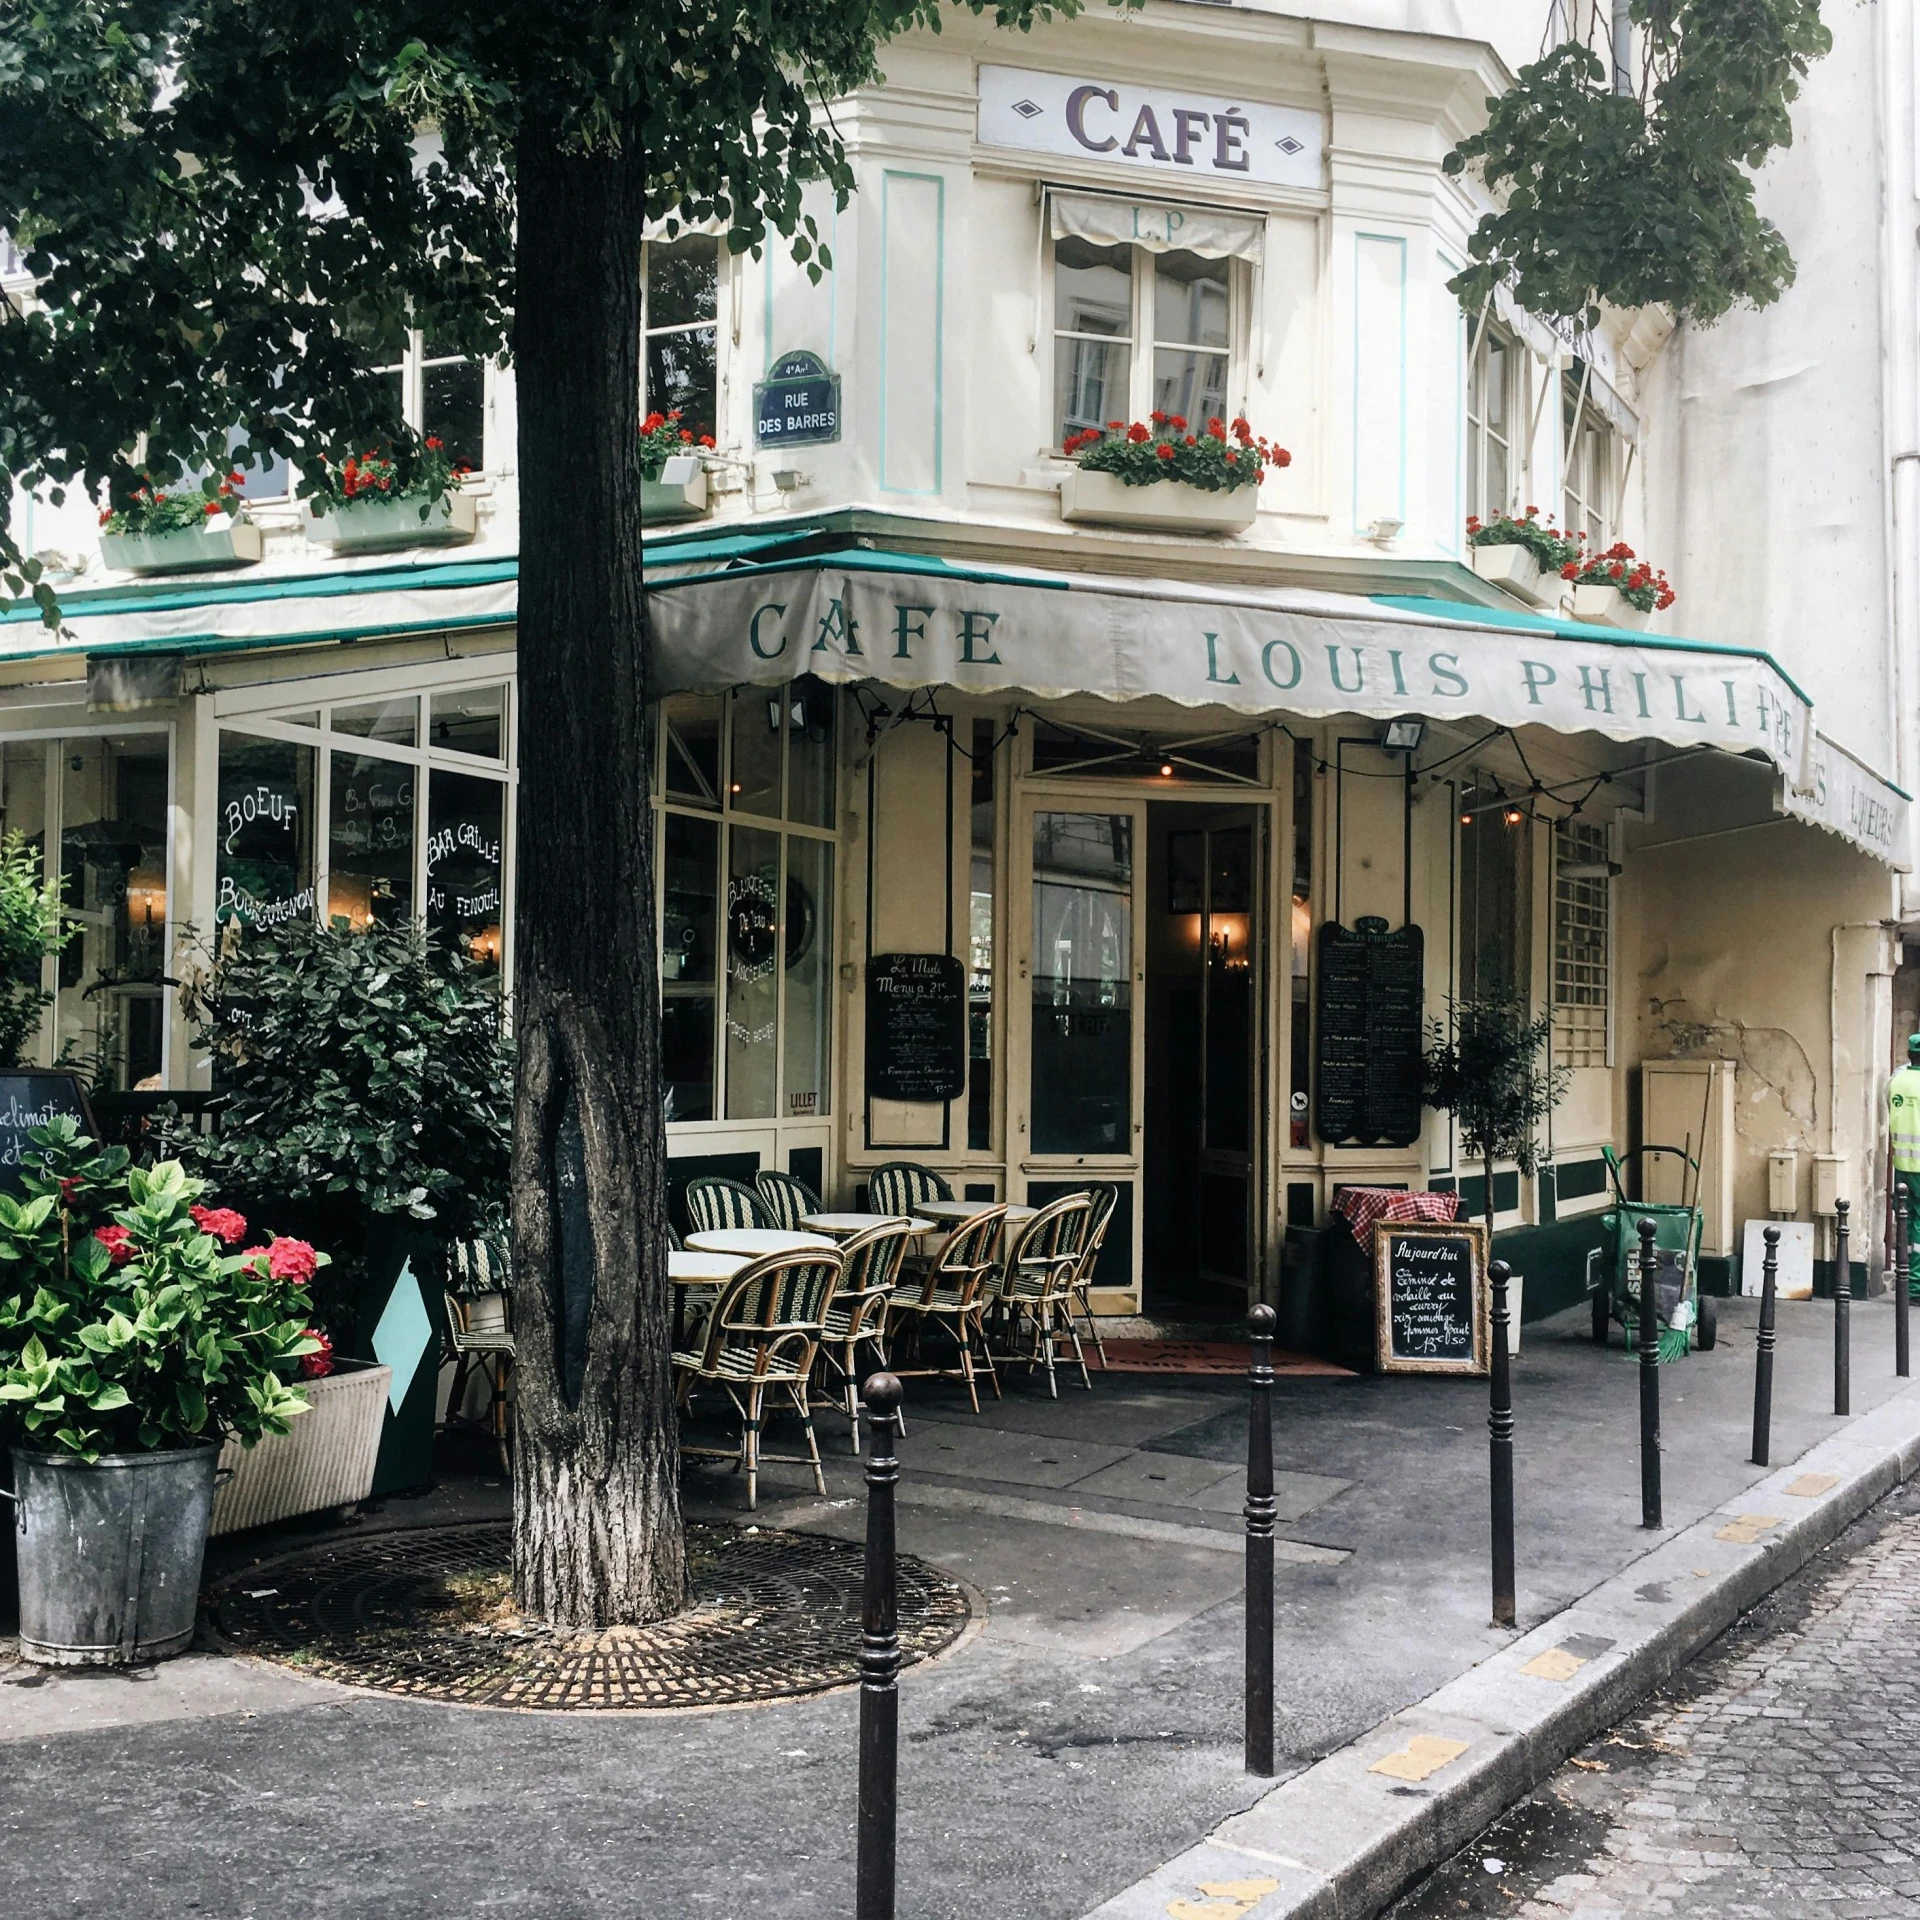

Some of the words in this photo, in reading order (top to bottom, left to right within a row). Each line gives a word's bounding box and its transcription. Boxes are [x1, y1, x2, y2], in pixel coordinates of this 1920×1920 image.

[1065, 85, 1250, 172] CAFÉ
[784, 392, 809, 409] RUE
[758, 417, 782, 434] DES
[787, 411, 835, 431] BARRES
[749, 597, 1002, 666] CAFE
[1203, 631, 1470, 698] LOUIS
[225, 786, 297, 855] BOEUF
[427, 828, 457, 877] BAR
[428, 887, 446, 915] AU
[876, 976, 915, 993] Menu
[0, 1095, 82, 1128] climatée
[790, 1092, 818, 1108] LILLET
[1395, 1241, 1459, 1262] Aujourd'hui
[1440, 1272, 1457, 1286] de
